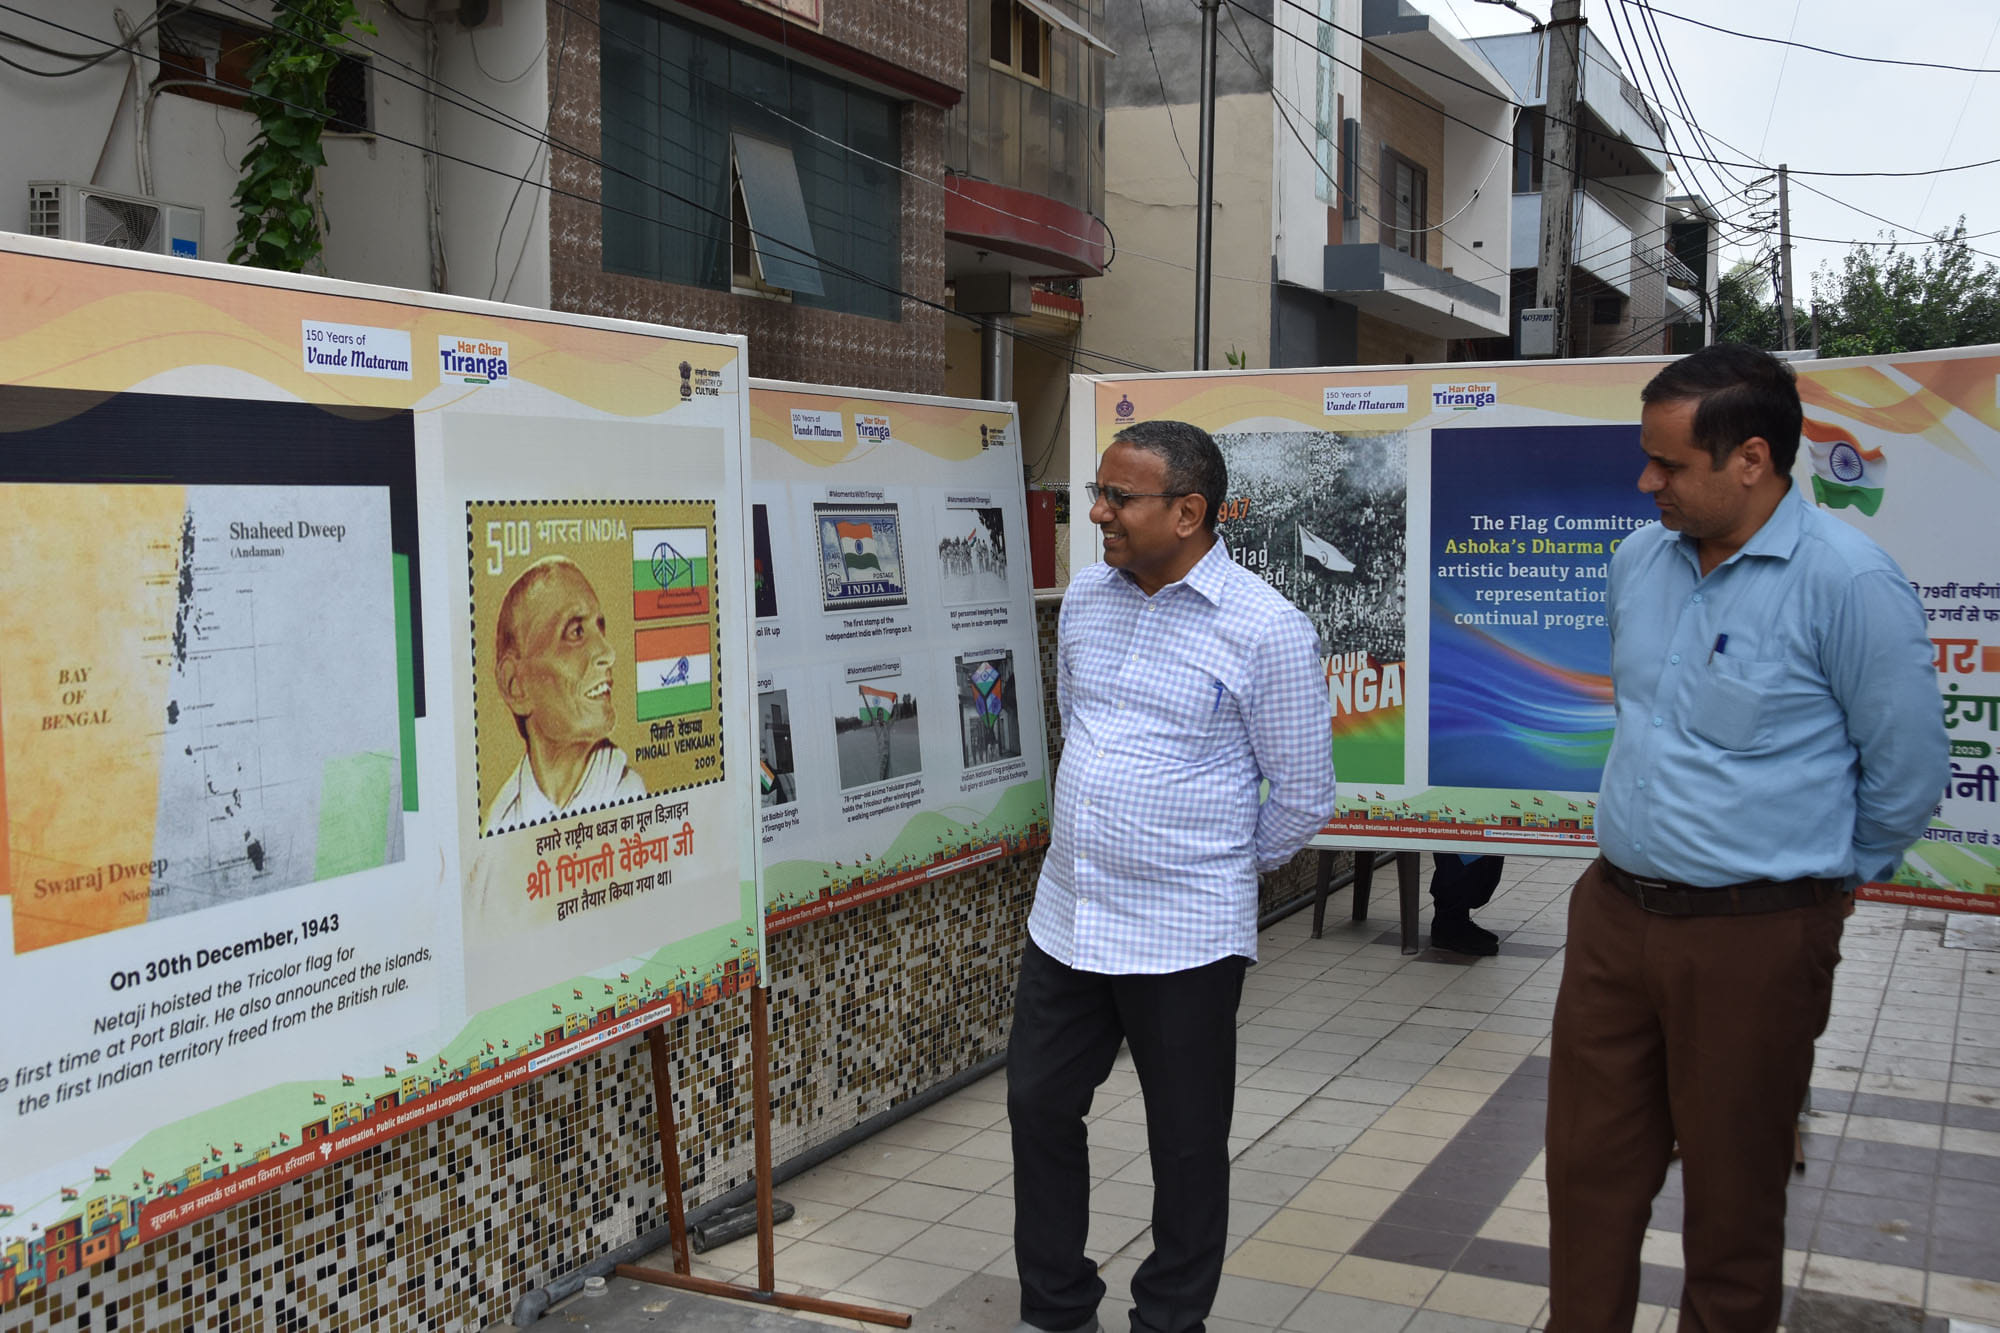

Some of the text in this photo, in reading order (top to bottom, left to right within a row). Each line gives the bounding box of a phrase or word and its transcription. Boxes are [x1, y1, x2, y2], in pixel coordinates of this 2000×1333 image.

[306, 329, 366, 345] 150 Years of
[457, 340, 503, 356] Har Ghar
[307, 346, 408, 372] Vande Mataram
[441, 349, 508, 380] Tiranga
[695, 387, 719, 396] CULTURE
[1326, 390, 1372, 399] 150 Years of
[1448, 384, 1491, 393] Har Ghar
[1326, 399, 1405, 411] Vande Mataram
[1433, 391, 1496, 408] Tiranga
[863, 416, 887, 425] Har Ghar
[793, 424, 842, 437] Vande Mataram
[856, 422, 890, 441] Tiranga
[229, 521, 347, 543] Shaheed Dweep
[536, 519, 583, 544] भारत
[585, 519, 628, 542] INDIA
[1471, 515, 1504, 531] The
[1510, 515, 1549, 534] Flag
[230, 545, 285, 559] (Andaman)
[1445, 538, 1526, 554] Ashoka's
[1531, 538, 1604, 554] Dharma
[1232, 546, 1268, 568] Flag
[1438, 562, 1608, 581] artistic beauty and
[848, 583, 885, 595] INDIA
[1923, 582, 1959, 599] 79वीं
[843, 616, 894, 628] The first stamp the
[1454, 610, 1539, 626] continual
[1939, 605, 1966, 621] गर्व
[1966, 605, 1980, 621] से
[772, 626, 781, 637] up
[872, 628, 883, 636] with
[883, 627, 902, 636] Tiranga
[1319, 650, 1368, 677] YOUR
[58, 667, 92, 685] BAY
[62, 690, 87, 707] OF
[41, 709, 112, 731] BENGAL
[636, 734, 715, 762] PINGALI VENKAIAH
[695, 755, 716, 770] 2009
[536, 828, 563, 856] हमारे
[565, 822, 593, 850] राष्ट्रीय
[596, 818, 618, 837] ध्वज
[620, 815, 634, 831] का
[637, 810, 653, 833] मूल
[1966, 828, 1989, 845] एवं
[526, 821, 695, 901] श्री पिंगली वेंकैया जी
[33, 857, 169, 899] Swaraj Dweep
[117, 884, 171, 905] (Nicobar)
[557, 897, 579, 921] द्वारा
[581, 888, 606, 911] तैयार
[609, 880, 634, 902] किया
[636, 875, 655, 894] गया
[110, 913, 340, 991] On 30th December, 1943
[93, 946, 355, 1035] Netaji hoisted the Tricolor flag for
[15, 1061, 53, 1088] first
[58, 1048, 101, 1074] time
[106, 1039, 125, 1058] at
[130, 1027, 165, 1051] Port
[169, 1013, 209, 1039] Blair.
[214, 1007, 235, 1025] He
[239, 996, 272, 1017] also
[275, 971, 356, 1006] announced
[360, 963, 381, 980] the
[384, 946, 432, 972] islands,
[18, 976, 409, 1116] the first Indian territory freed from the British rule.
[335, 1065, 527, 1150] Information, Public Relations And Languages Department, Haryana
